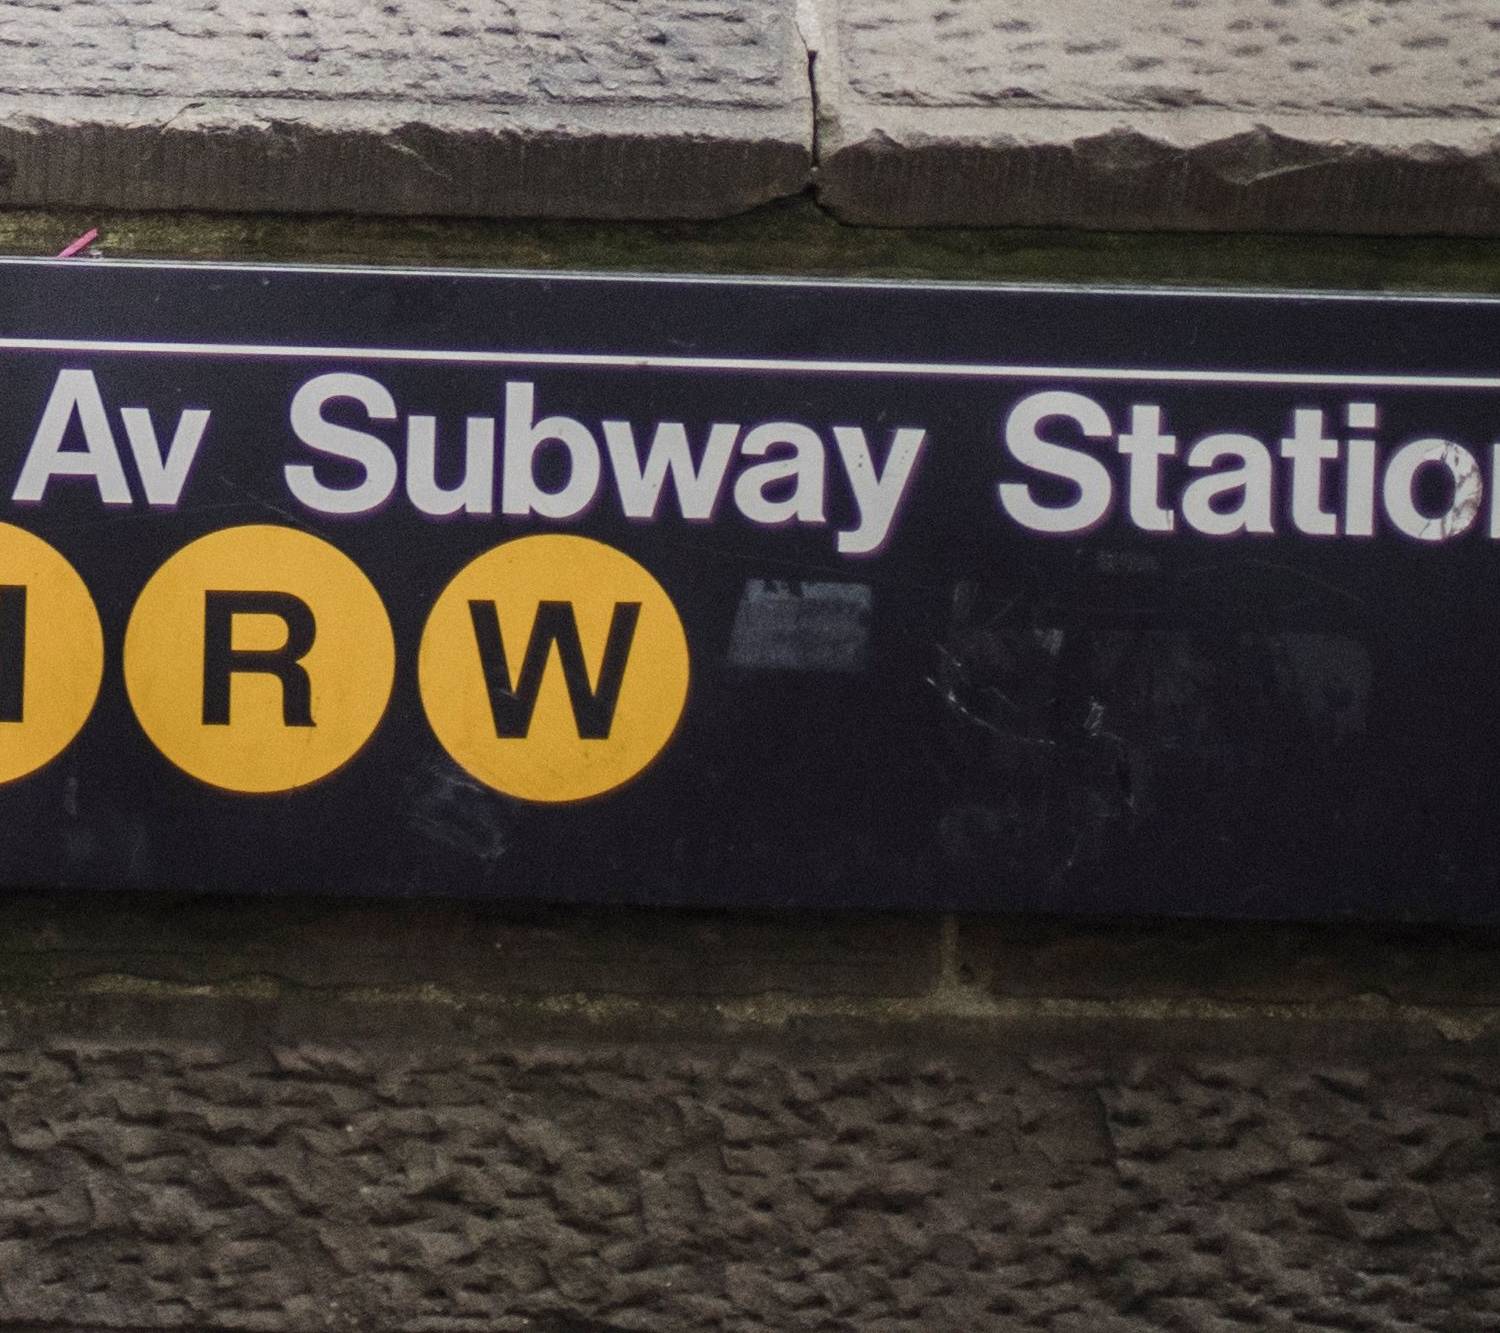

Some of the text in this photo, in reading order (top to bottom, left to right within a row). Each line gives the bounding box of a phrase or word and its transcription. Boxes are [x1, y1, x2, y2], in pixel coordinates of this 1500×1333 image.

[11, 369, 213, 507] Av
[284, 373, 926, 555] Subway
[200, 590, 317, 728] R
[467, 599, 643, 740] W
